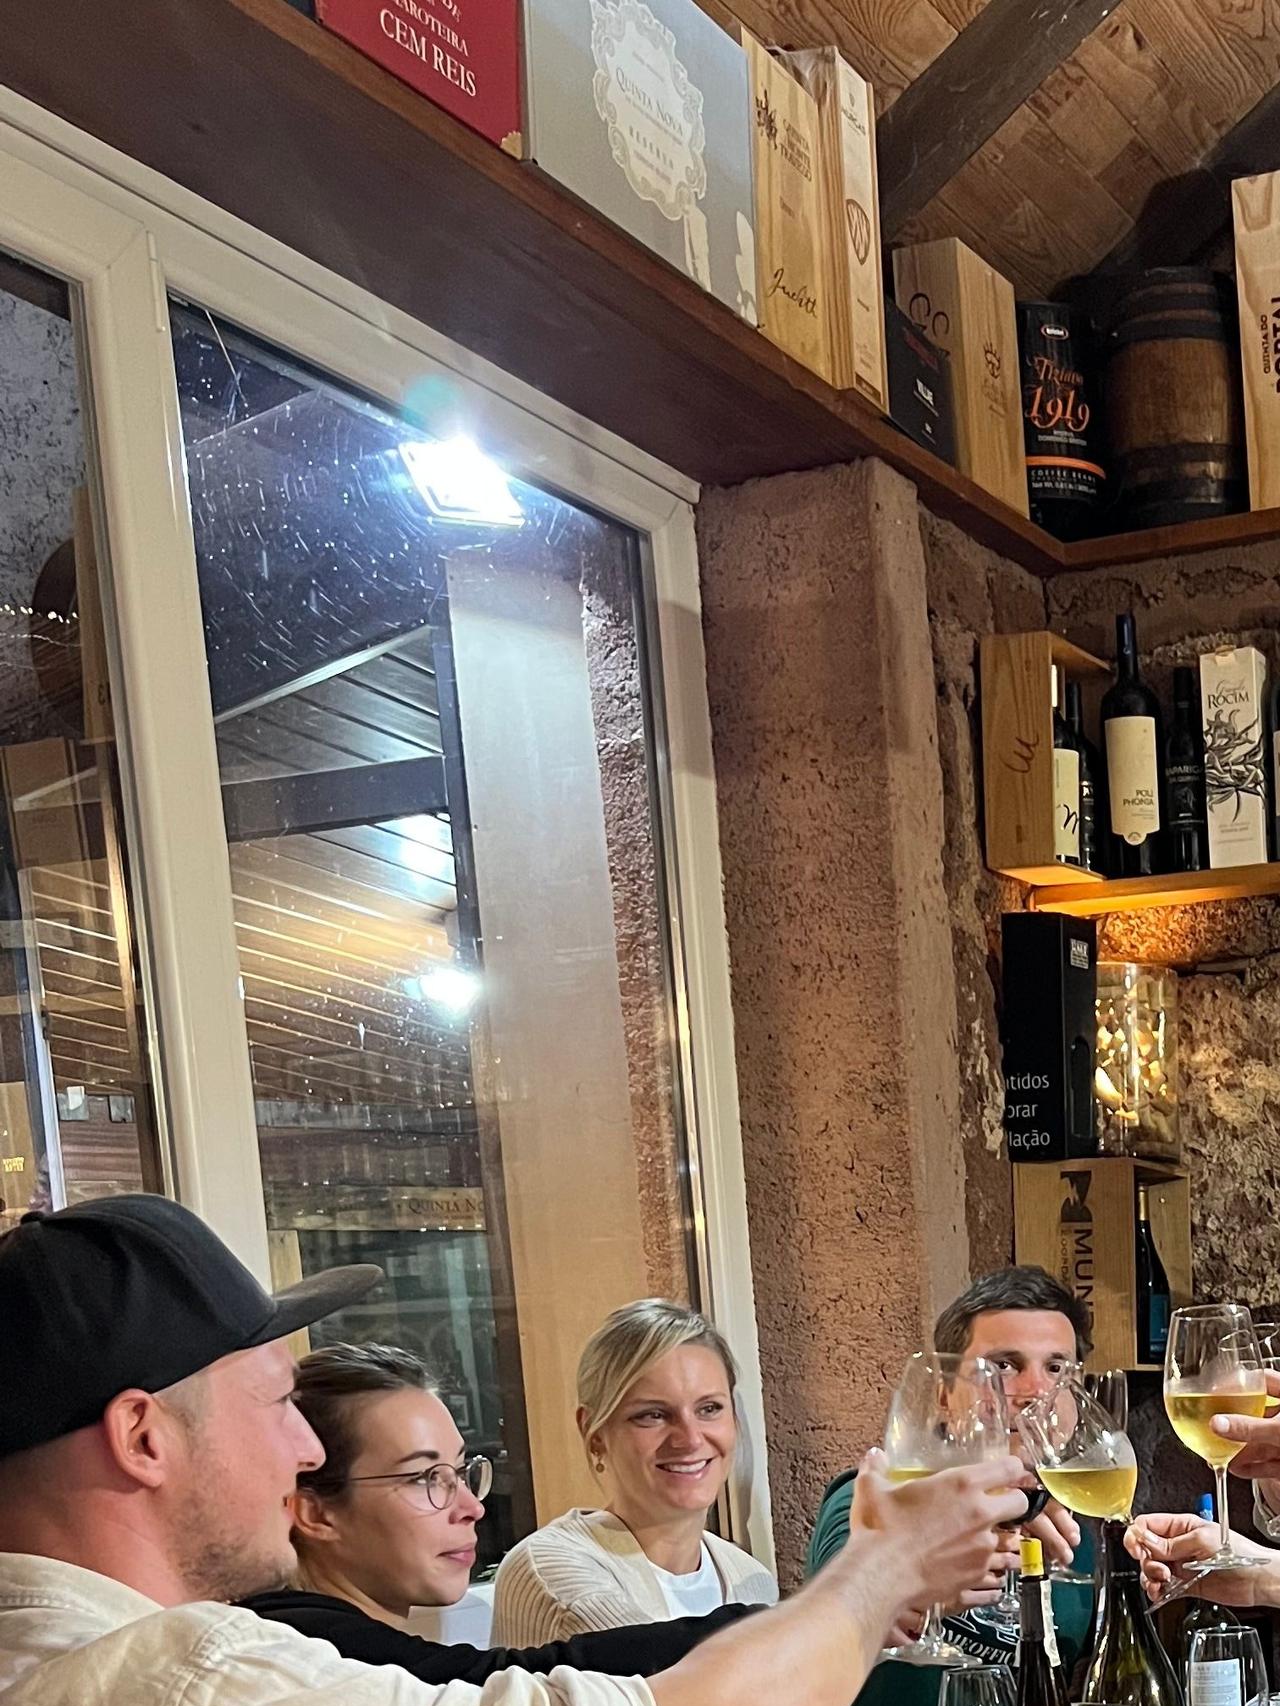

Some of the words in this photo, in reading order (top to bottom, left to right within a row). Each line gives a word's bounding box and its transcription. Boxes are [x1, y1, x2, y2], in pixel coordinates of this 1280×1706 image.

[380, 9, 427, 63] CEM
[432, 43, 477, 97] REIS
[1260, 314, 1268, 331] DO
[1262, 332, 1271, 374] QUINTA
[1207, 690, 1251, 709] ROCIM
[1009, 1128, 1050, 1150] lação
